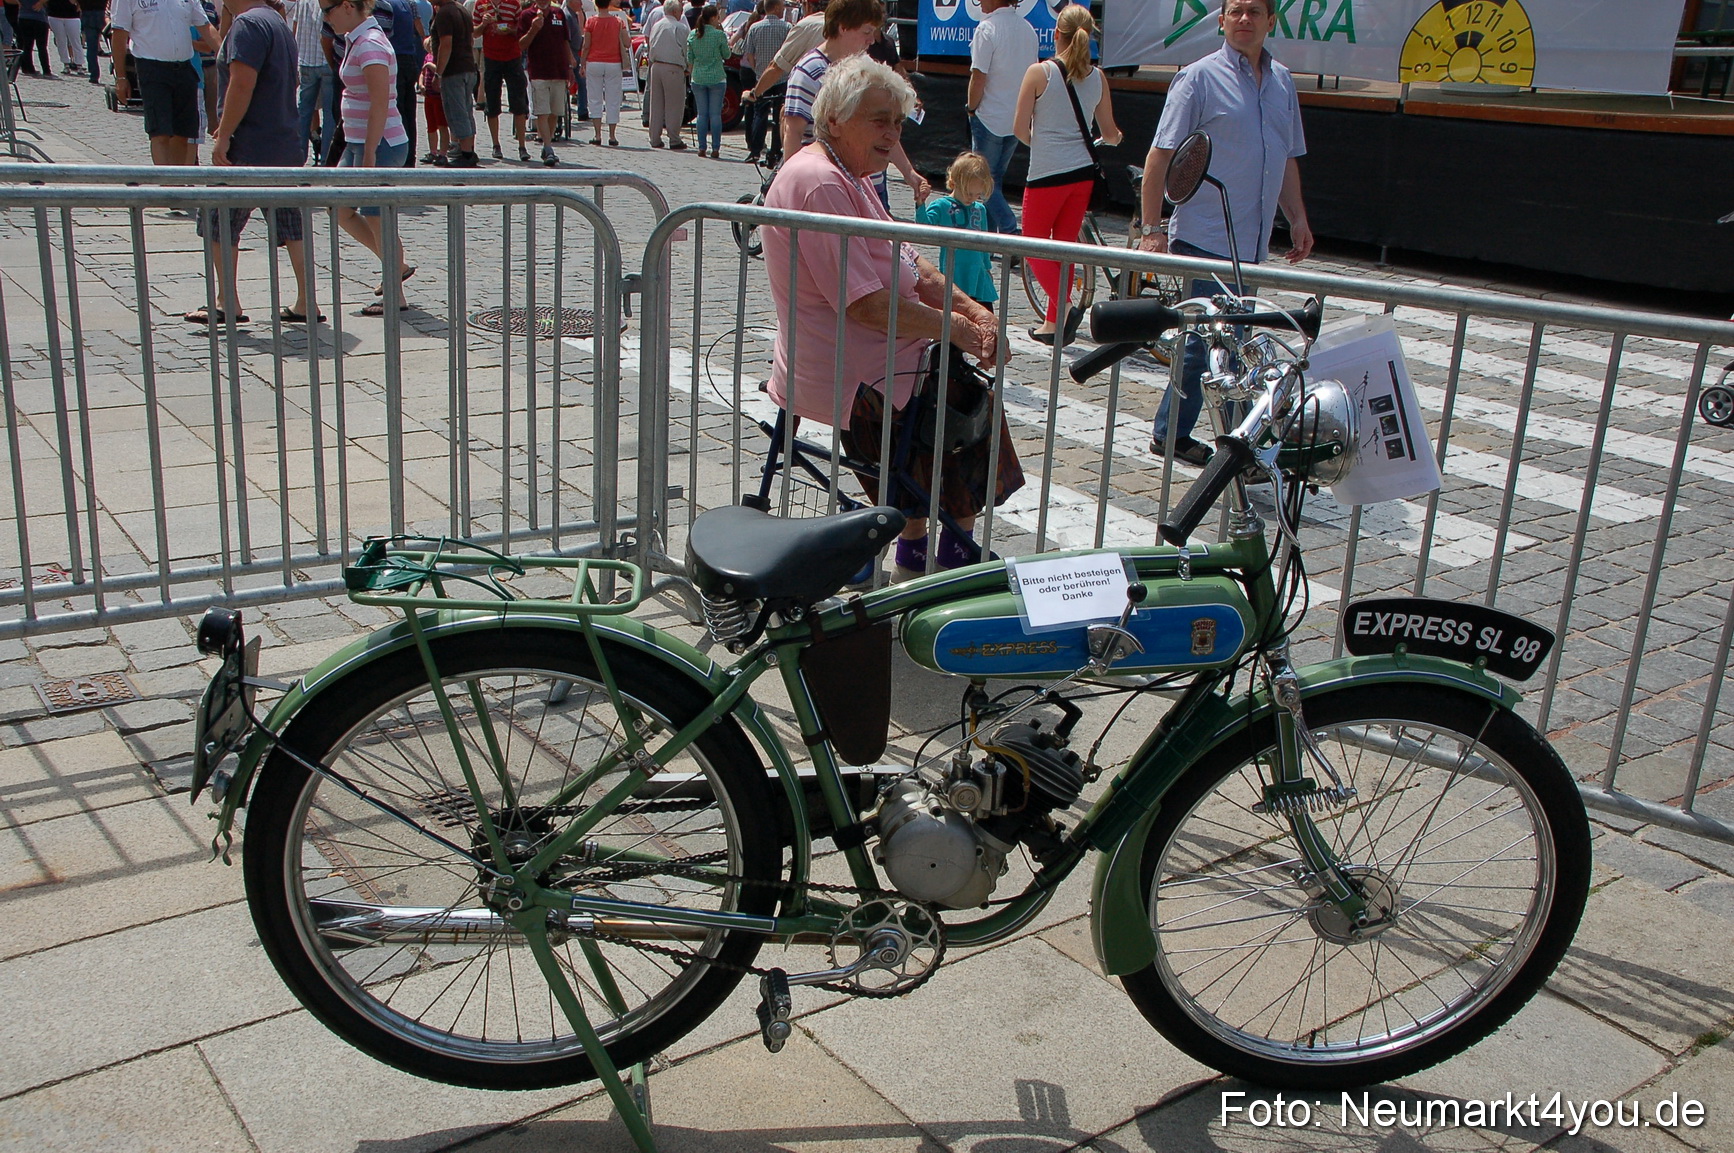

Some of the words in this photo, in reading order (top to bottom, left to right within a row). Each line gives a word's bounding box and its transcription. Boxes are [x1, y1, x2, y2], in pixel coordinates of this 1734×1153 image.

[1217, 0, 1357, 43] KRA
[1445, 14, 1456, 31] 1
[1465, 3, 1483, 24] 12
[1484, 8, 1504, 32] 11
[1423, 35, 1441, 51] 2
[1496, 29, 1518, 53] 10
[1413, 62, 1432, 74] 3
[1022, 577, 1045, 586] Bitte
[1047, 572, 1072, 583] nicht
[1074, 567, 1121, 579] besteigen
[1038, 585, 1061, 594] oder
[1063, 577, 1111, 591] berühren!
[1062, 590, 1093, 601] Danke
[1353, 611, 1473, 645] EXPRESS
[1475, 626, 1504, 654] SL
[1510, 636, 1541, 663] 98
[982, 641, 1059, 656] EXPRESS
